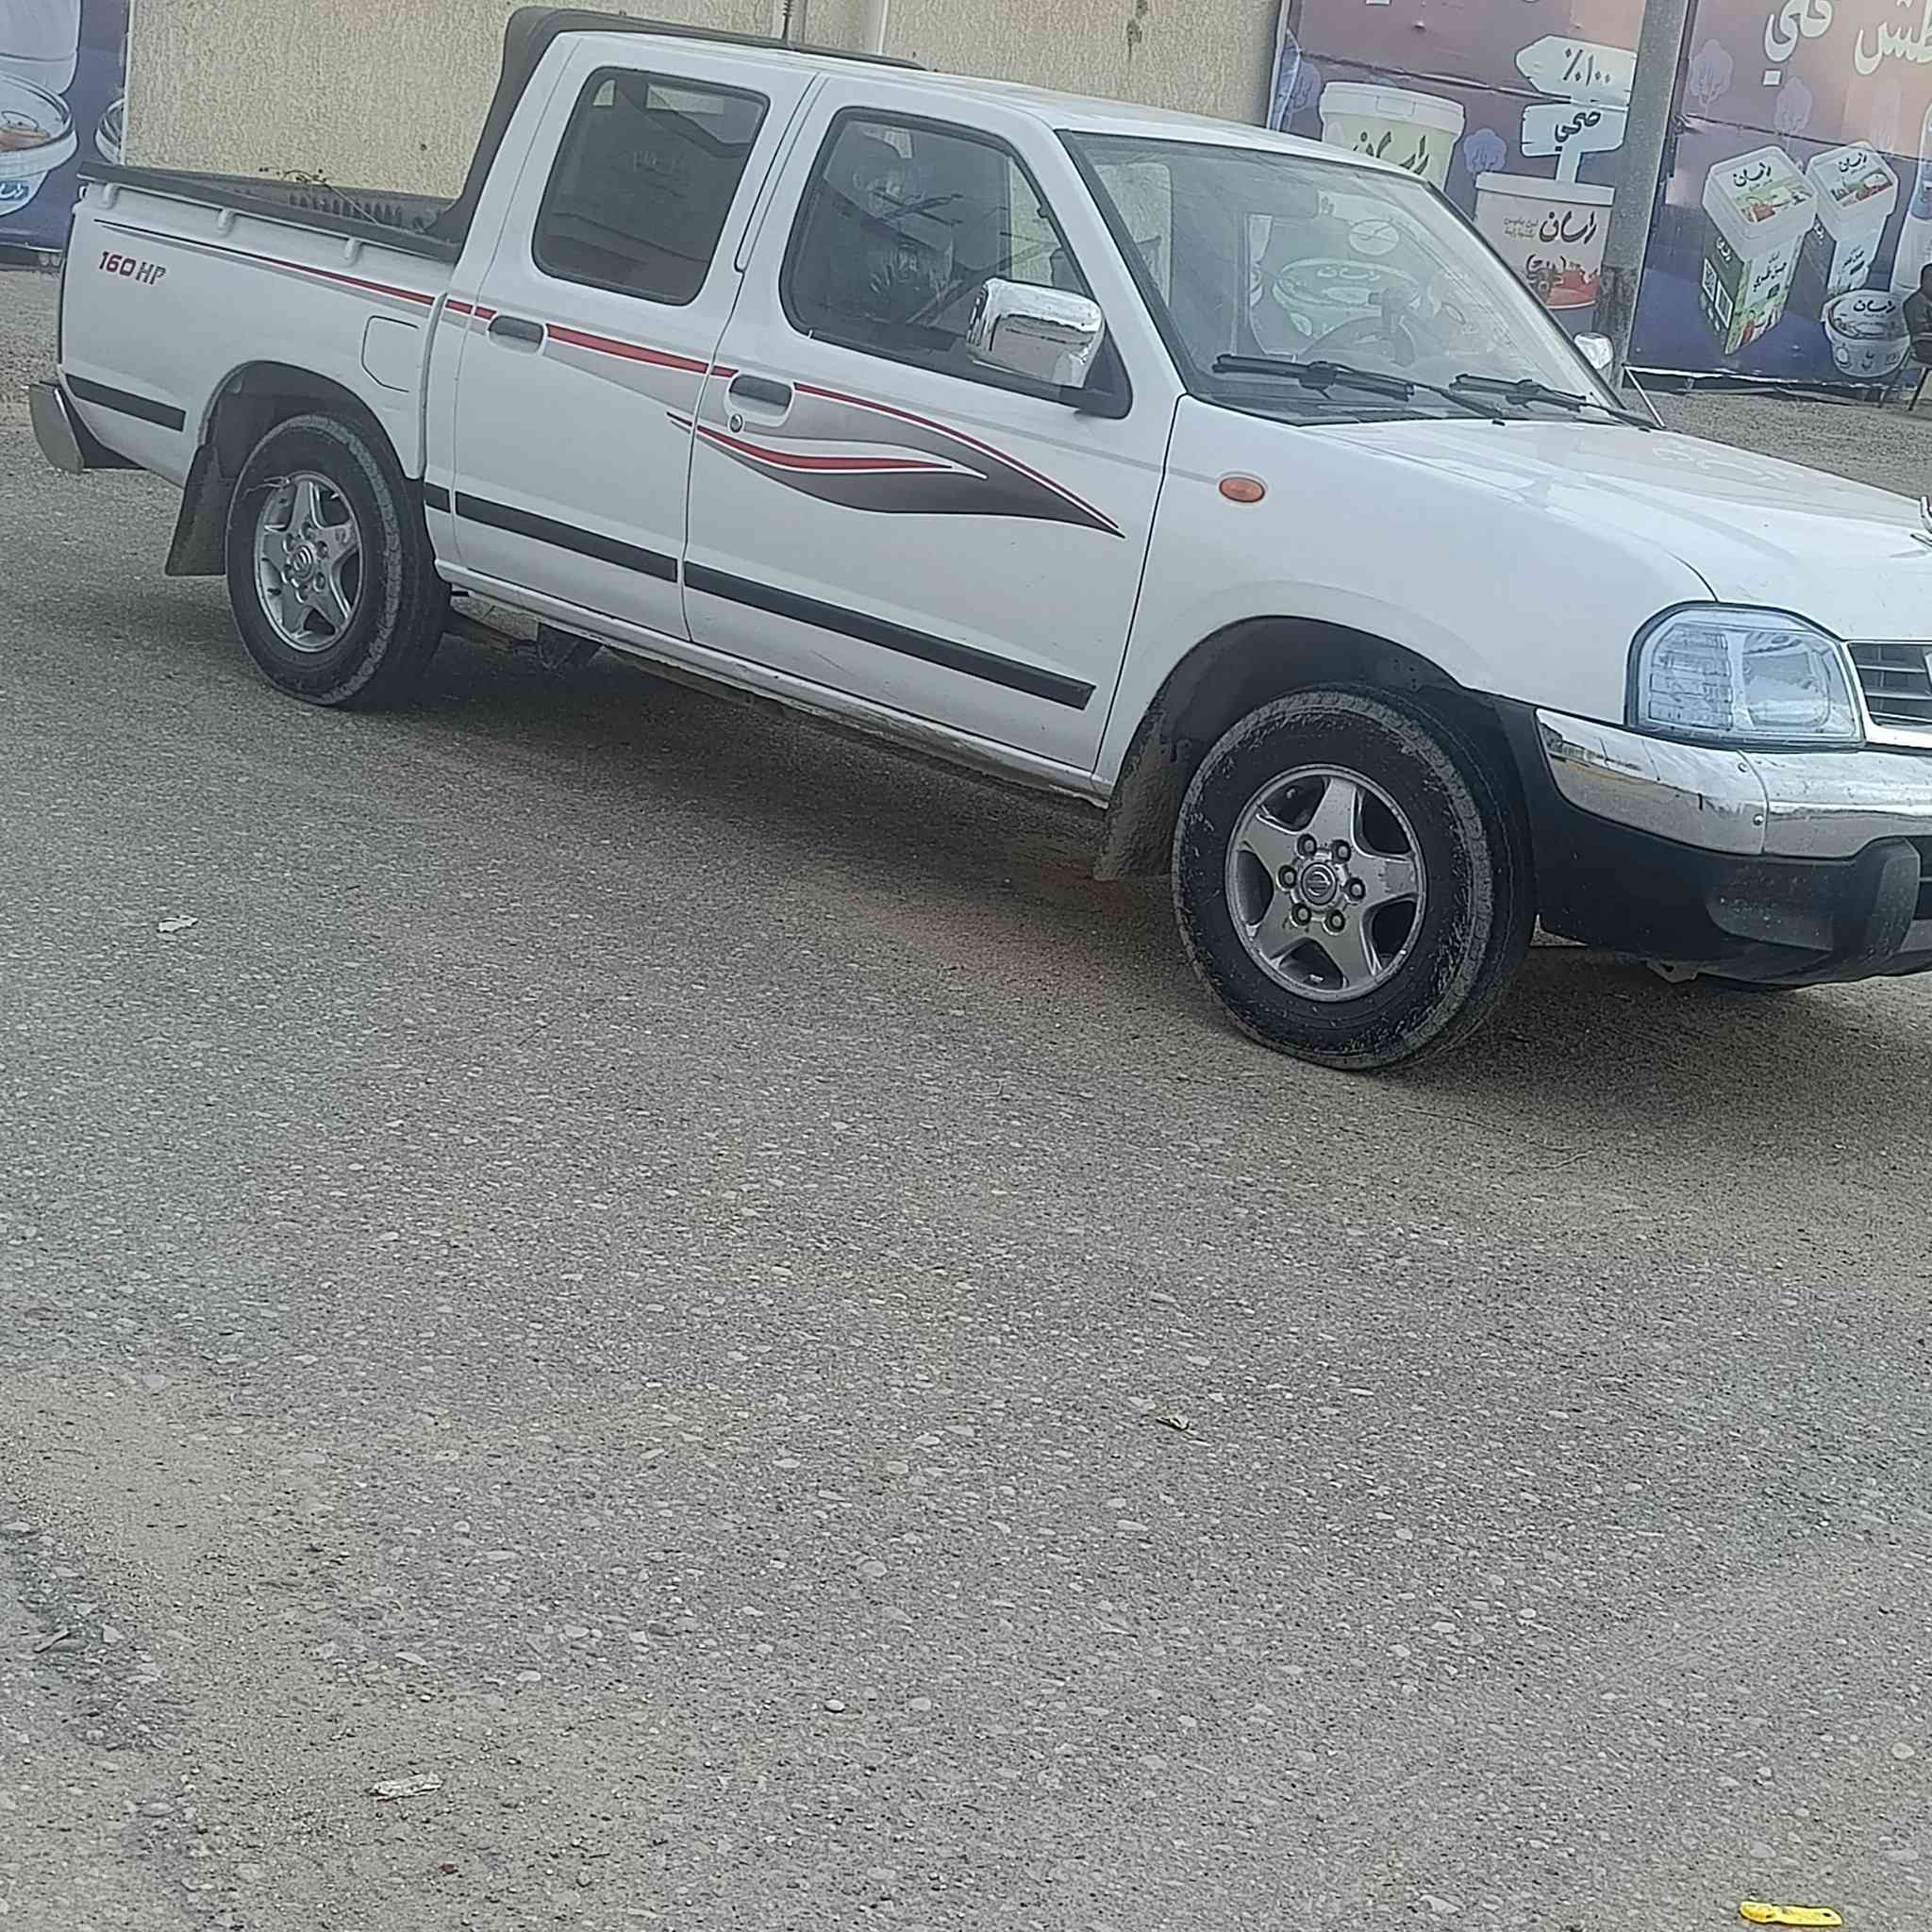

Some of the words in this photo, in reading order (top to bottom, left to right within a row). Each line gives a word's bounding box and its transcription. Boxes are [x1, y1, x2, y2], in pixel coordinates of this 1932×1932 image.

[1555, 111, 1601, 151] صحي
[99, 251, 137, 276] 160
[136, 261, 166, 285] HP
